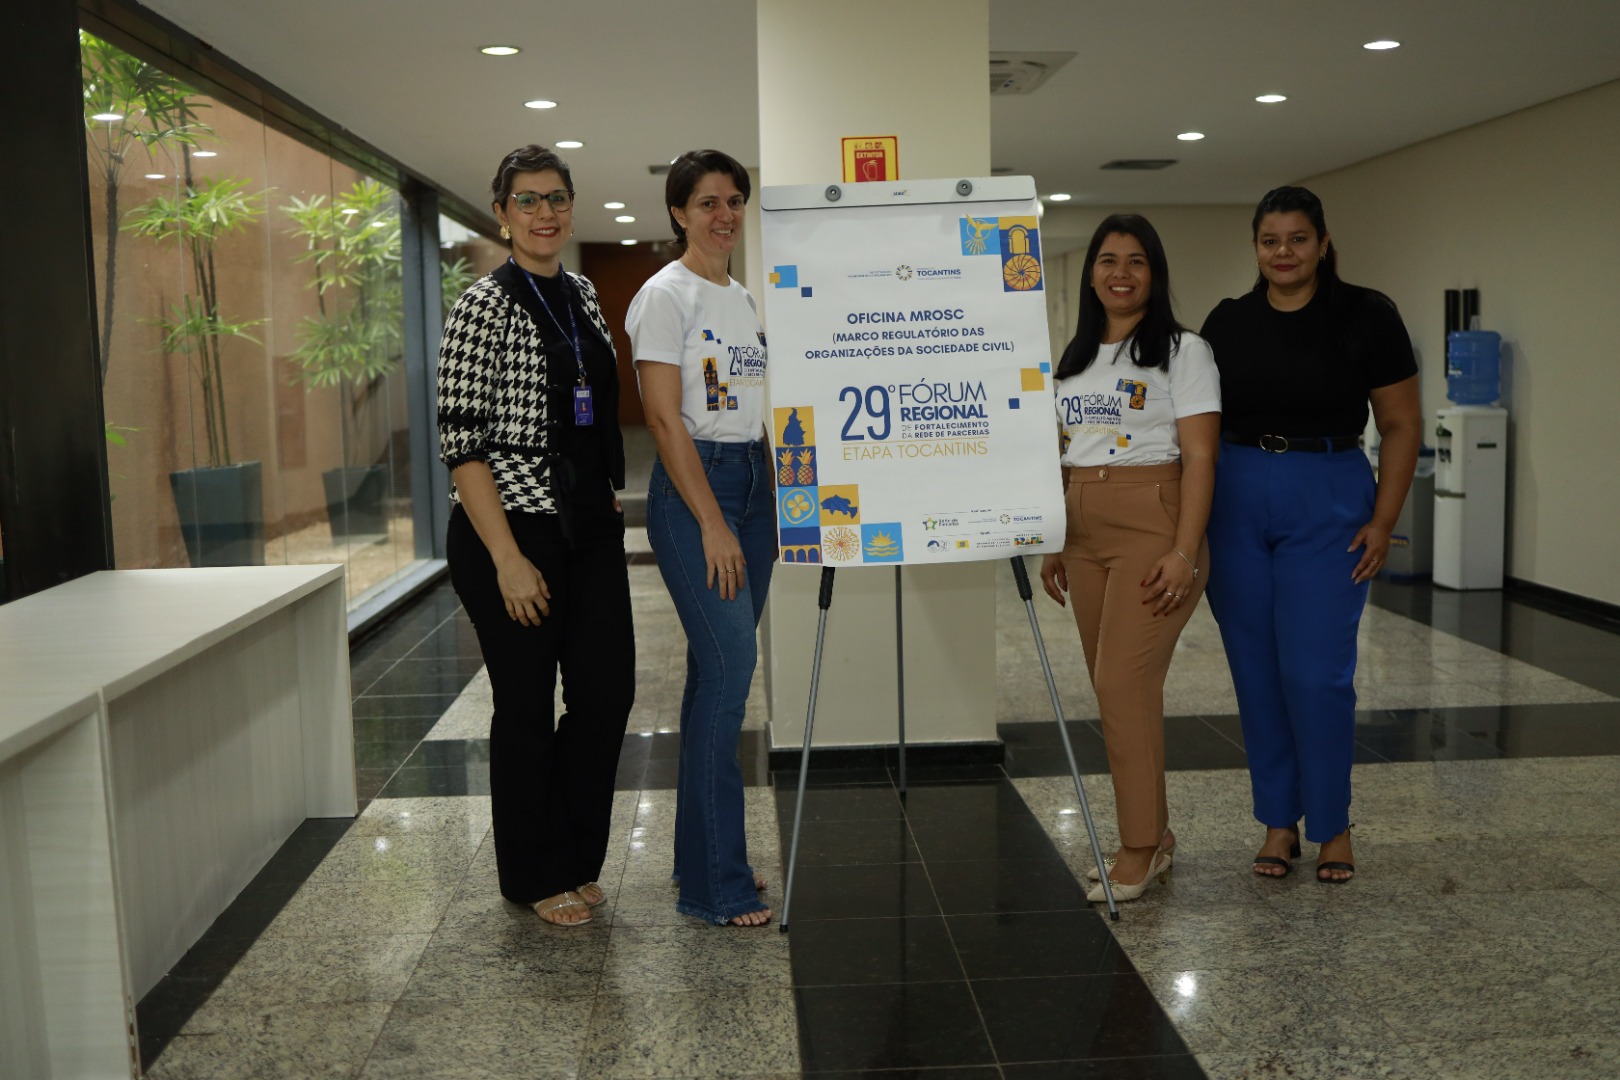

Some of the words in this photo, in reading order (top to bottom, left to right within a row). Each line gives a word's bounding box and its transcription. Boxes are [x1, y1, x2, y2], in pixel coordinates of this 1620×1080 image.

[917, 268, 961, 277] TOCANTINS
[847, 311, 906, 324] OFICINA
[909, 308, 965, 322] MROSC
[832, 332, 879, 345] (MARCO
[881, 326, 959, 340] REGULATÓRIO
[961, 327, 985, 337] DAS
[805, 345, 895, 360] ORGANIZAÇÕES
[899, 346, 914, 356] DA
[916, 343, 979, 354] SOCIEDADE
[982, 341, 1015, 352] CIVIL)
[899, 377, 987, 404] FÓRUM
[1084, 391, 1122, 408] FÓRUM
[900, 404, 988, 422] REGIONAL
[1084, 406, 1122, 417] REGIONAL
[914, 421, 990, 431] FORTALECIMENTO
[947, 429, 990, 437] PARCERIAS
[843, 446, 893, 461] ETAPA
[897, 441, 989, 458] TOCANTINS
